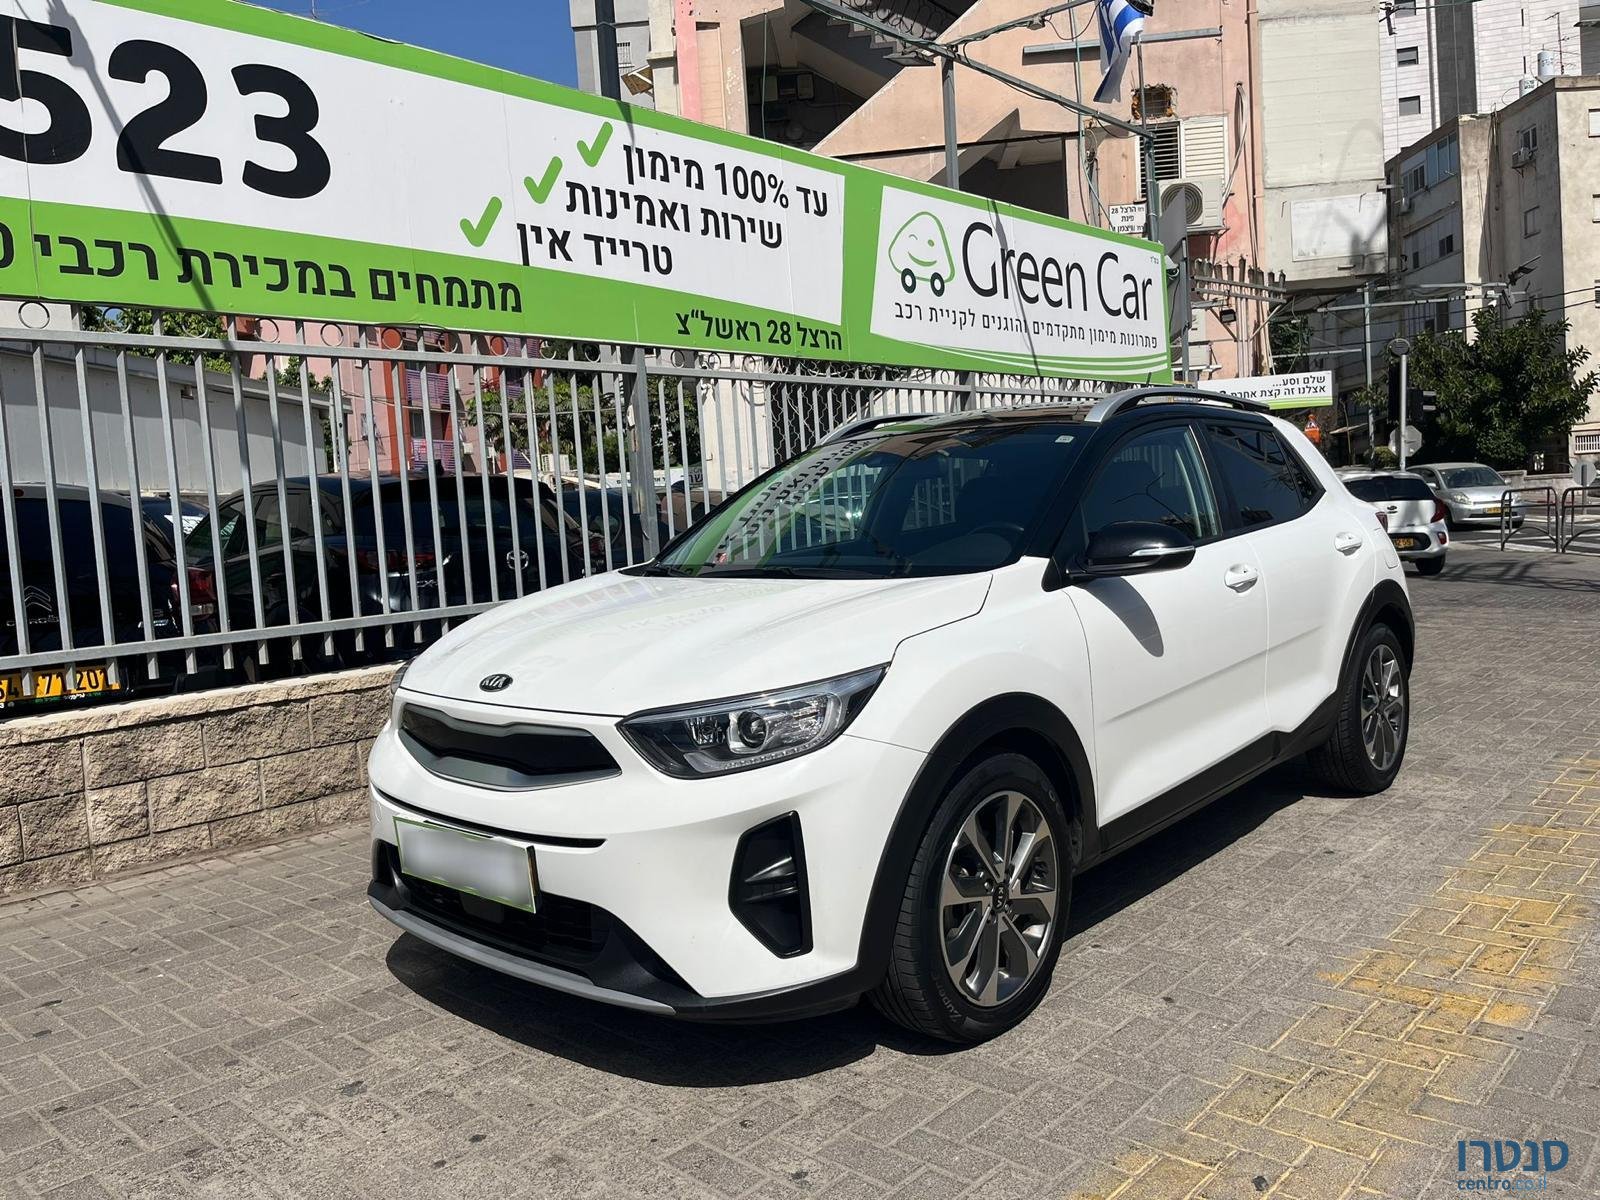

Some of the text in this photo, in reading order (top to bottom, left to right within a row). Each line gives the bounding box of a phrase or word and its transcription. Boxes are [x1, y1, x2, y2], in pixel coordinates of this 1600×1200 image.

[622, 144, 829, 217] עד 100% מימון
[565, 181, 783, 249] שירות ואמינות
[34, 233, 160, 281] רכבי
[516, 222, 673, 275] טרייד אין
[962, 221, 1152, 321] Green Car
[177, 247, 356, 299] במכירת
[368, 267, 523, 313] מתמחים
[766, 319, 792, 345] 28
[797, 321, 842, 351] הרצל
[894, 302, 1158, 349] פתרונות מימון מתקדמים והוגנים לקניית רכב
[1260, 387, 1281, 398] קצת
[1283, 387, 1295, 396] זה
[1298, 385, 1326, 395] אצלנו
[1303, 375, 1326, 384] שלם
[481, 675, 507, 688] KIA
